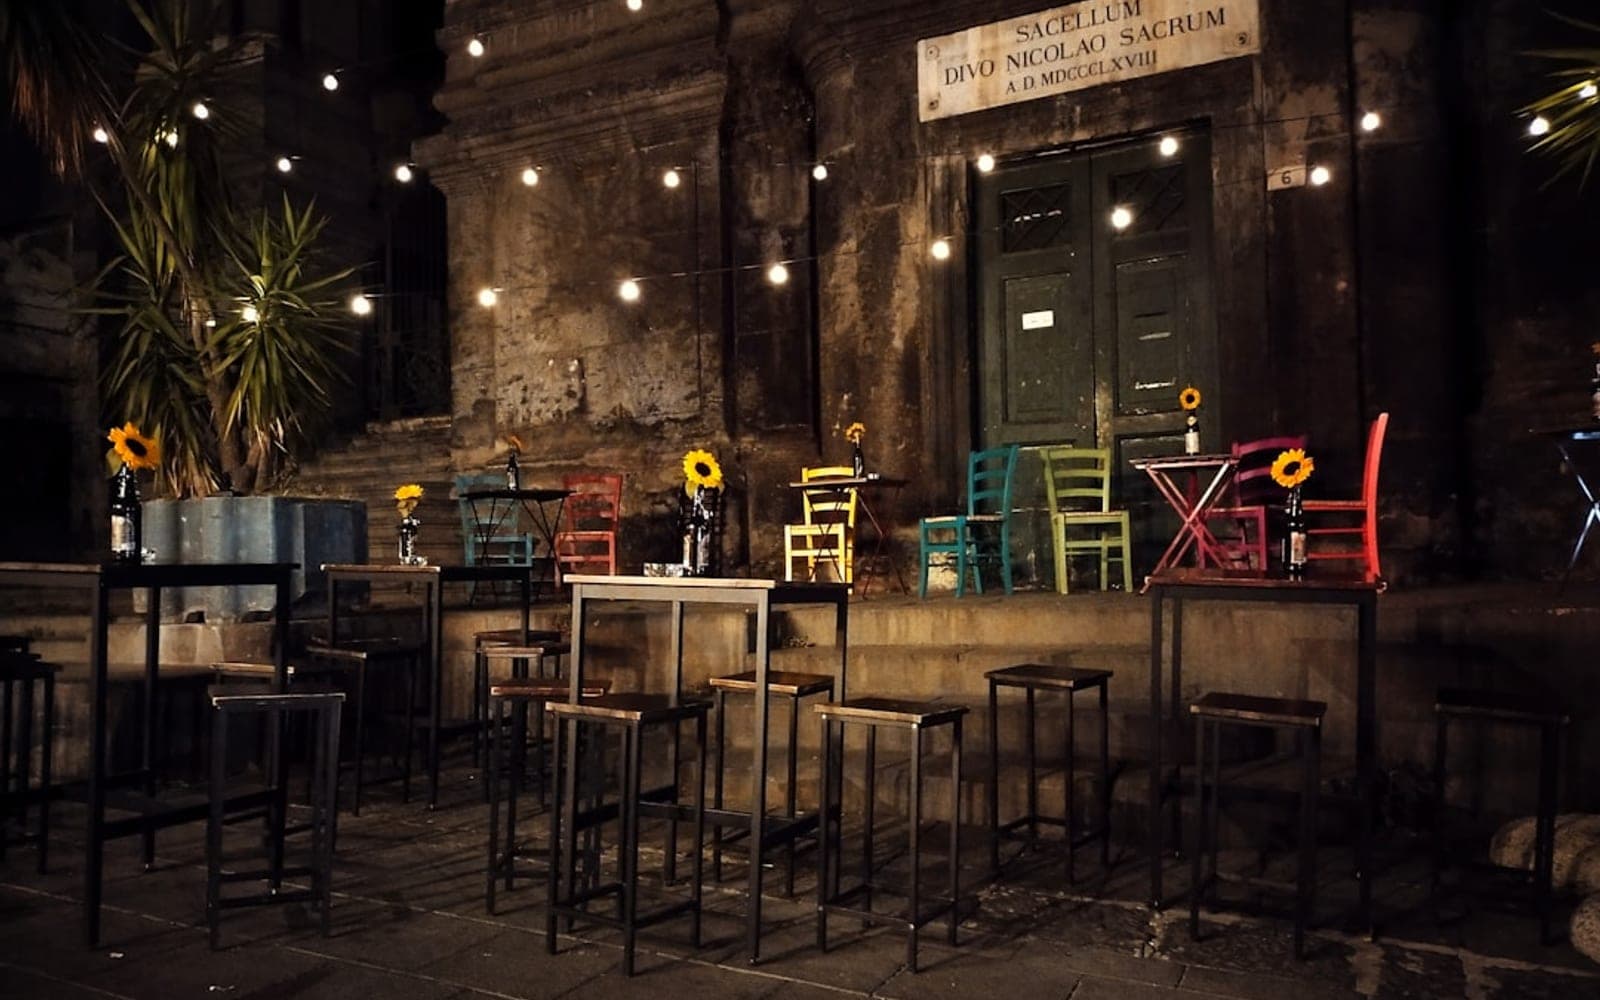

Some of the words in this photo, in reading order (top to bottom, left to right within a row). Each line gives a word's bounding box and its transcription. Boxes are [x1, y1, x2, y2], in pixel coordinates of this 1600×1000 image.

[1016, 0, 1142, 43] SACELLUM
[944, 59, 995, 85] DIVO
[1006, 34, 1105, 72] NICOLAO
[1119, 7, 1226, 46] SACRUM
[1041, 50, 1157, 86] MDCCCLXVIII
[1281, 170, 1292, 185] 6
